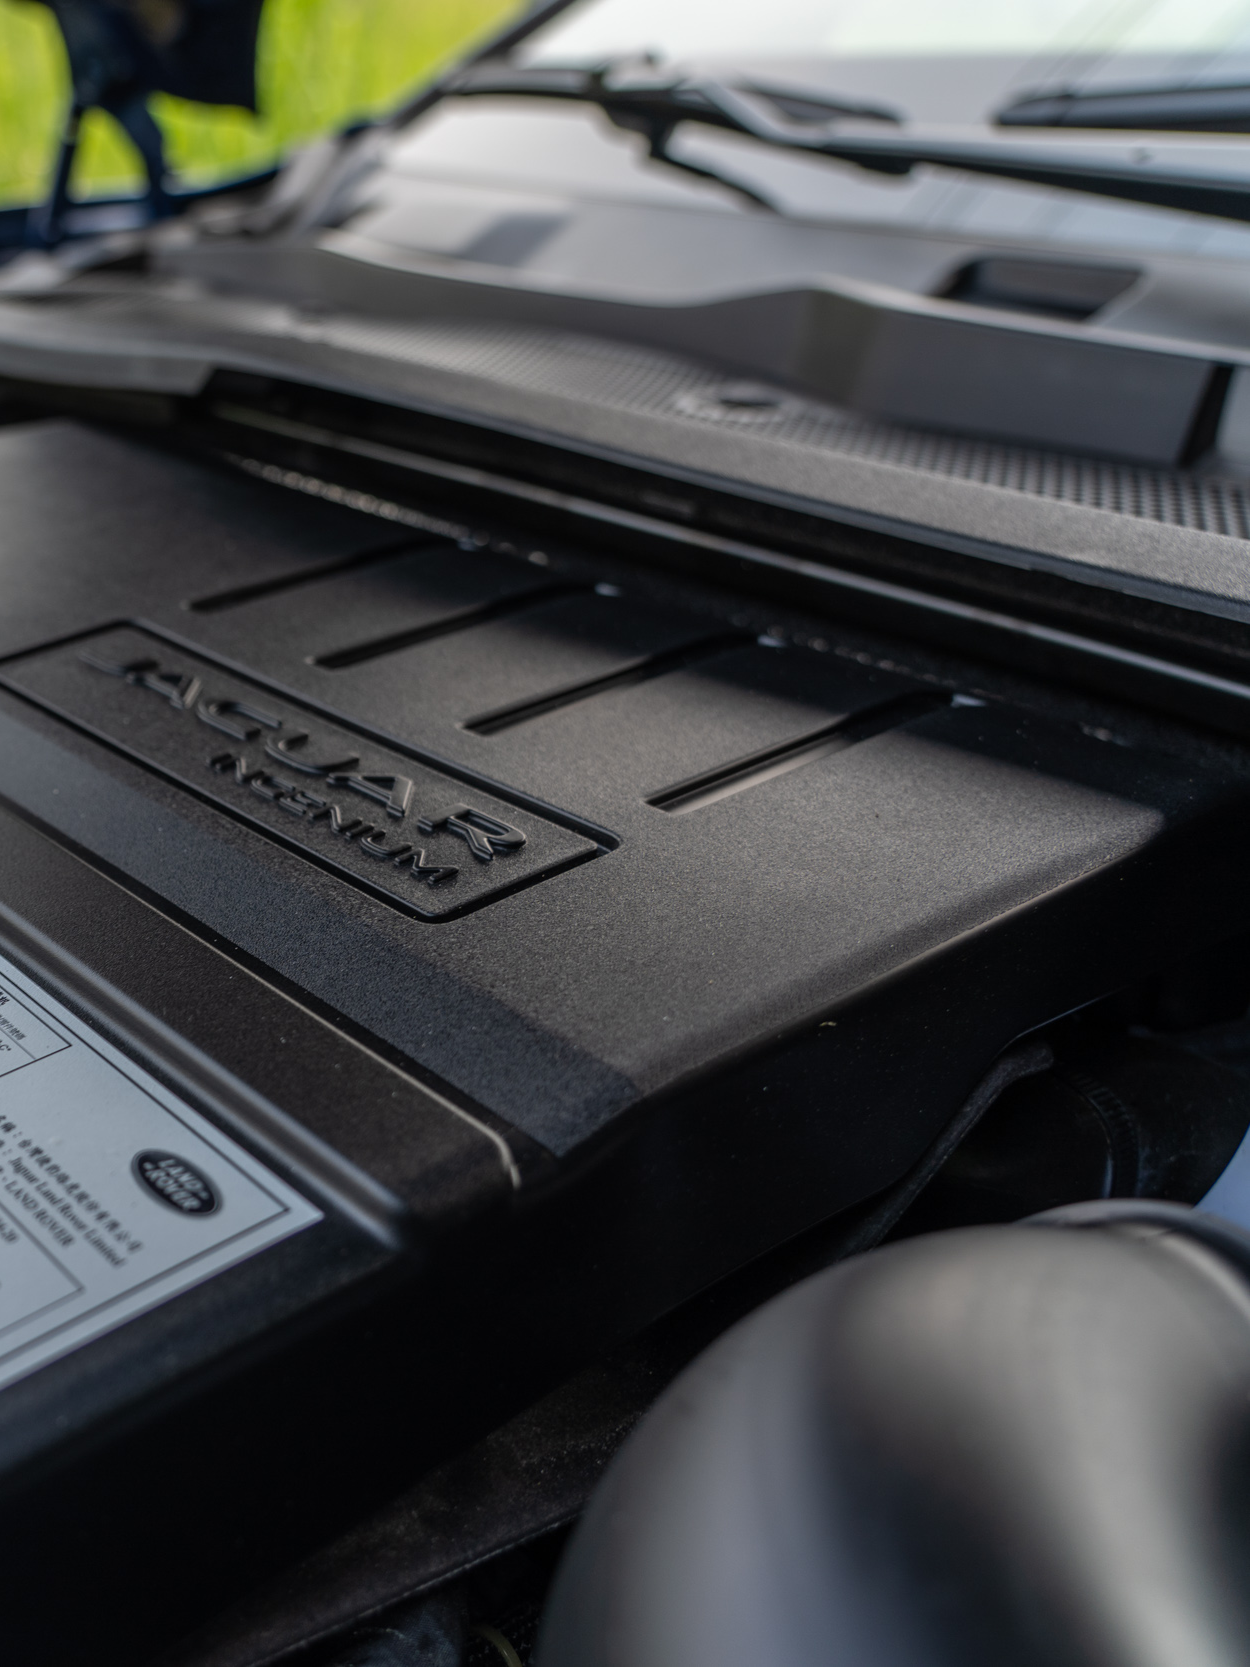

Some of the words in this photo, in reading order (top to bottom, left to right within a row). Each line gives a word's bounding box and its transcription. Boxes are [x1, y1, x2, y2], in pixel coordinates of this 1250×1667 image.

[207, 752, 460, 887] INGENIUM
[142, 1165, 203, 1214] ROVER
[156, 1156, 204, 1193] LAND
